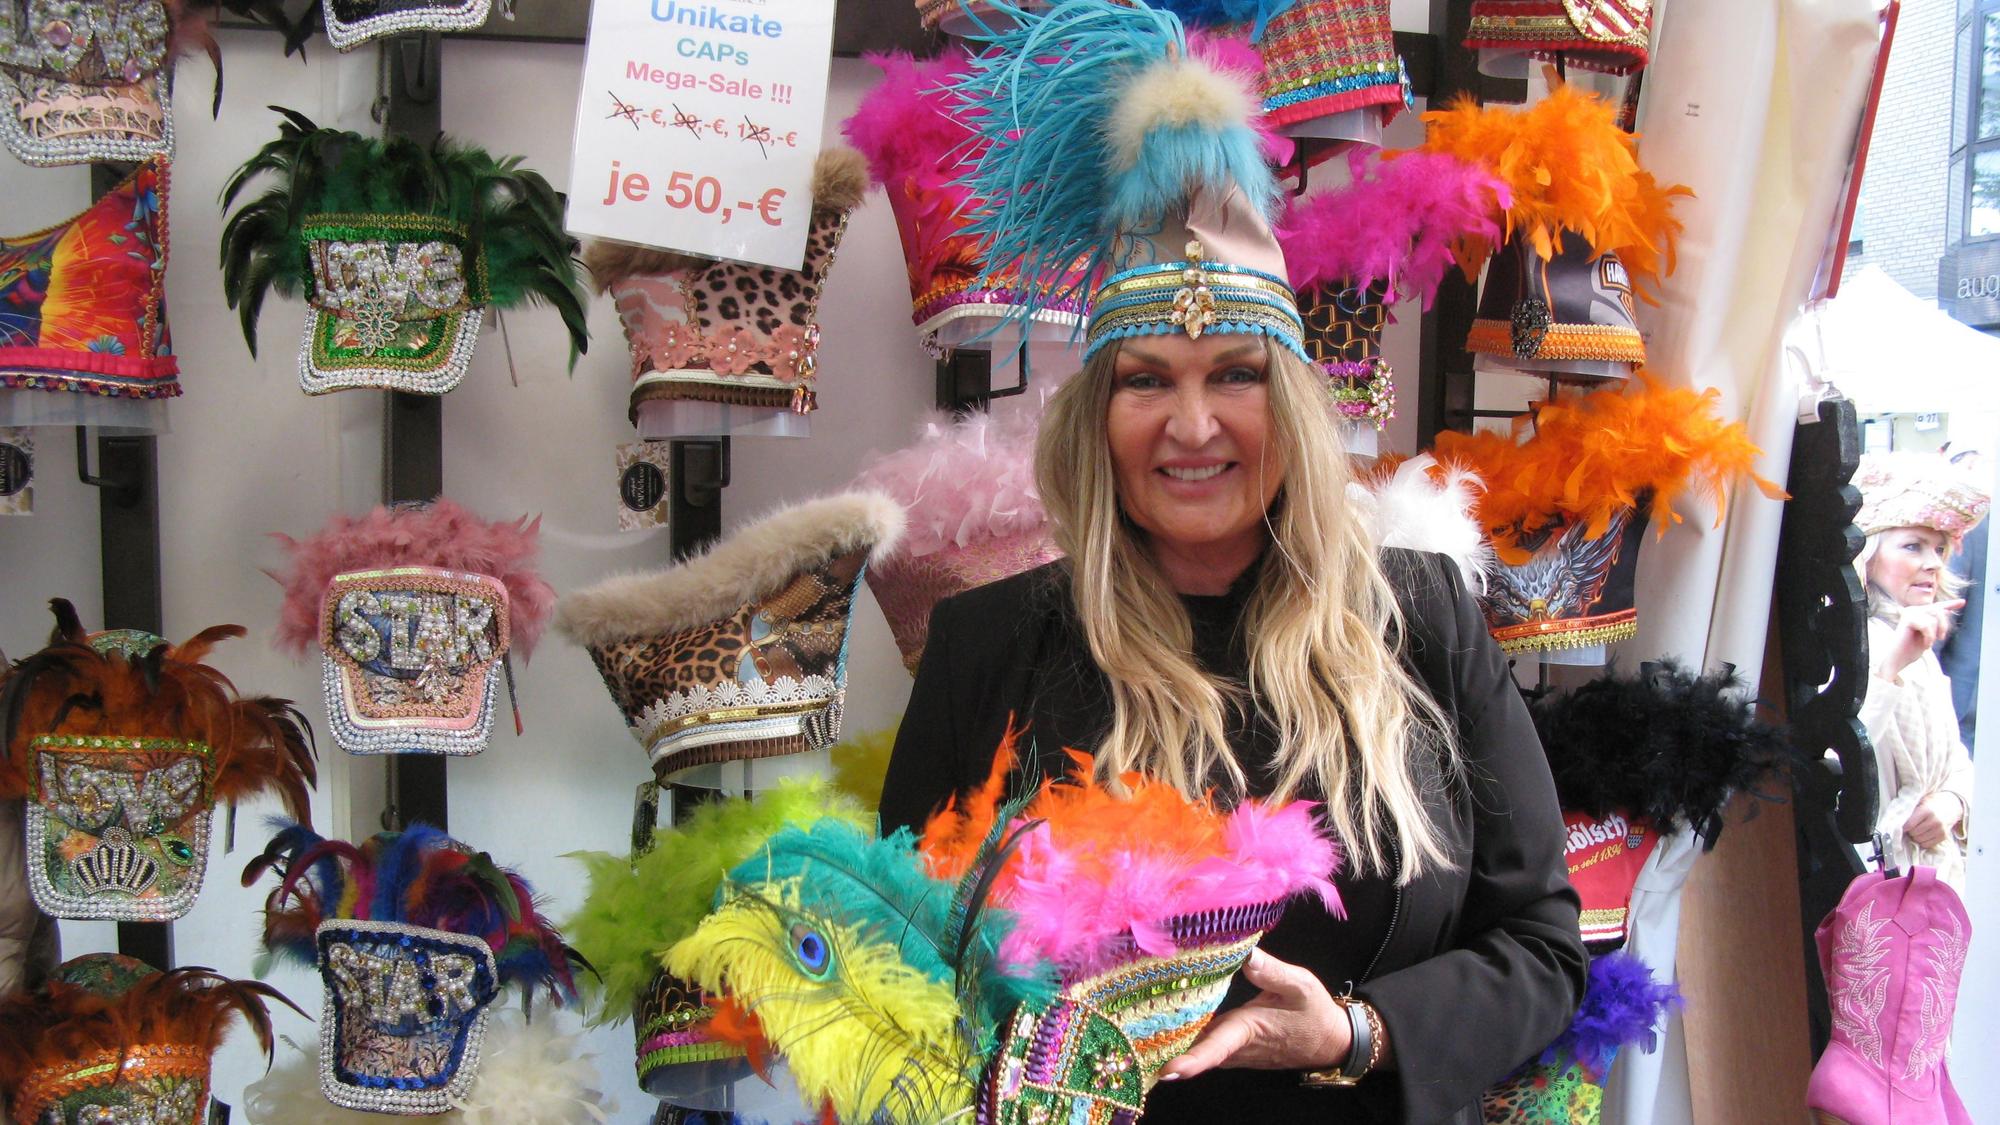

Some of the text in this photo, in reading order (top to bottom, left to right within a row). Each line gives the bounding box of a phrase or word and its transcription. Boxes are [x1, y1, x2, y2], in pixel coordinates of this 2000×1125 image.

[651, 0, 783, 38] Unikate
[677, 37, 750, 66] CAPs
[626, 60, 793, 105] Mega-Sale !!!
[603, 161, 788, 227] je 50,-€
[338, 590, 493, 669] STAR
[1563, 811, 1628, 857] ölsch
